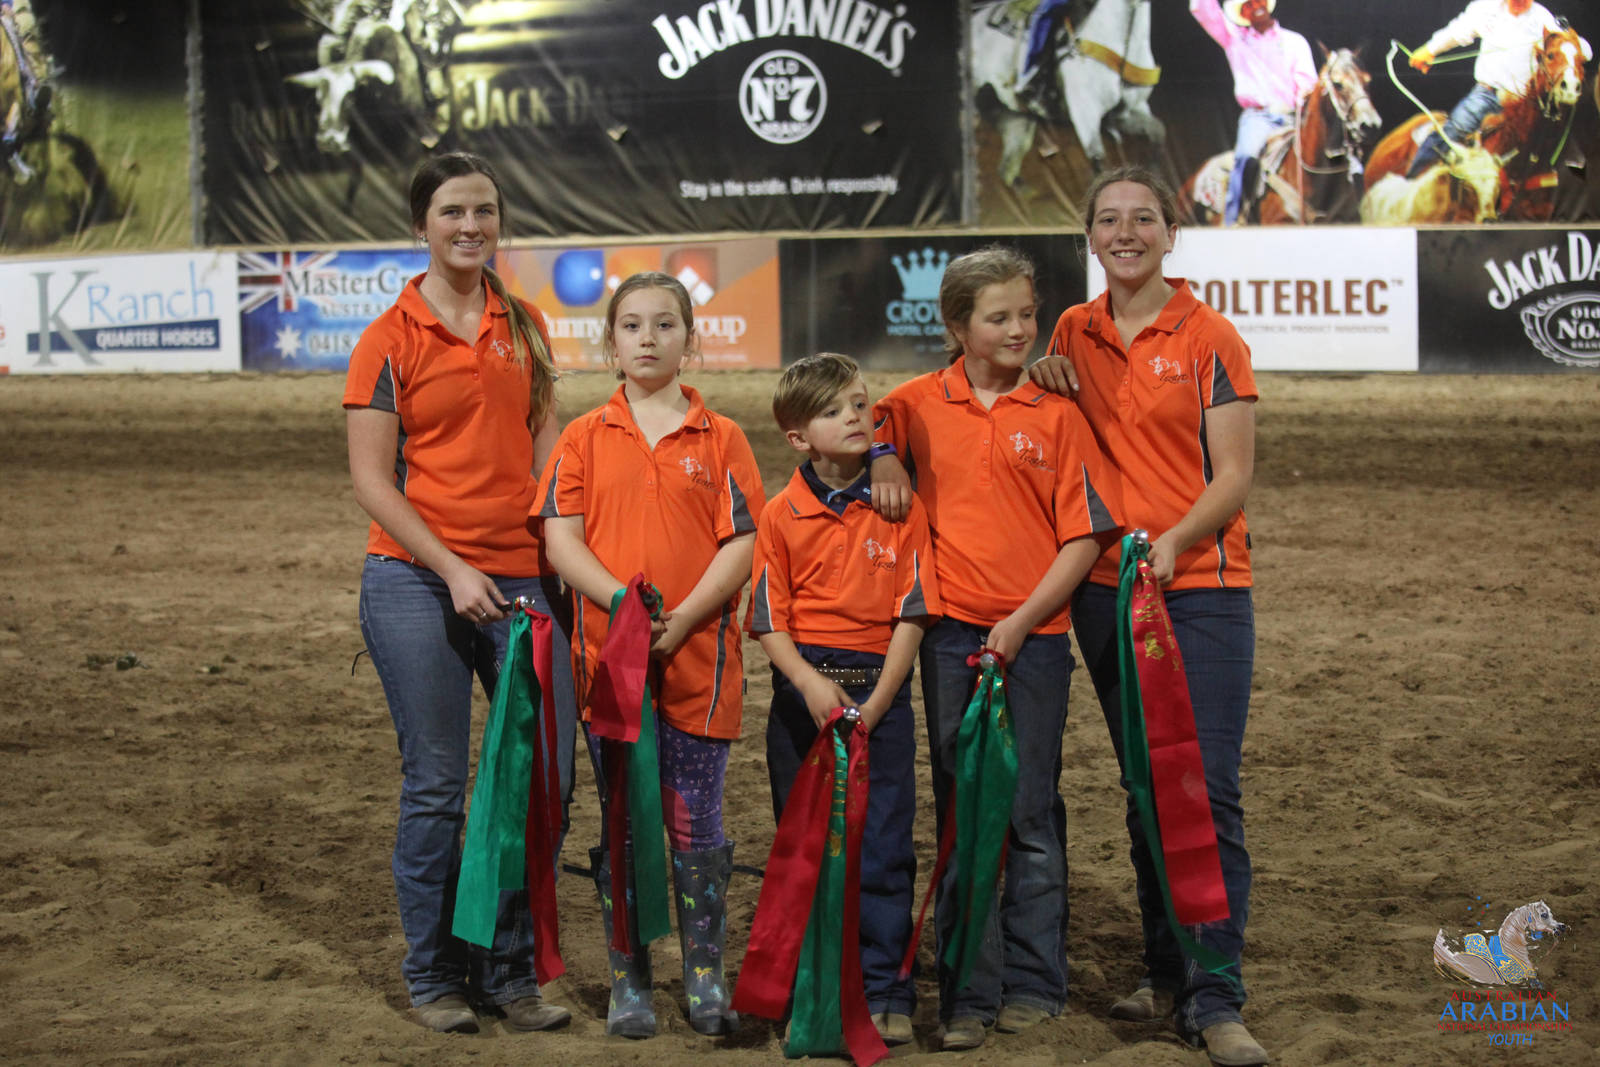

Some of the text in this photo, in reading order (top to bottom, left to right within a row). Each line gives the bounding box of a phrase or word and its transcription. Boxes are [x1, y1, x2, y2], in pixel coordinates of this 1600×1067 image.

[652, 0, 916, 79] JACK DANIEL'S
[763, 58, 799, 76] OLD
[461, 76, 553, 131] JACK
[680, 180, 707, 201] Stay
[709, 180, 722, 197] in
[723, 179, 744, 197] the
[790, 176, 825, 195] Drink
[1484, 245, 1567, 310] JACK
[30, 260, 214, 366] K Ranch
[321, 302, 391, 317] AUSTRA
[96, 328, 216, 350] QUARTER HORSES
[541, 310, 747, 345] unny oup
